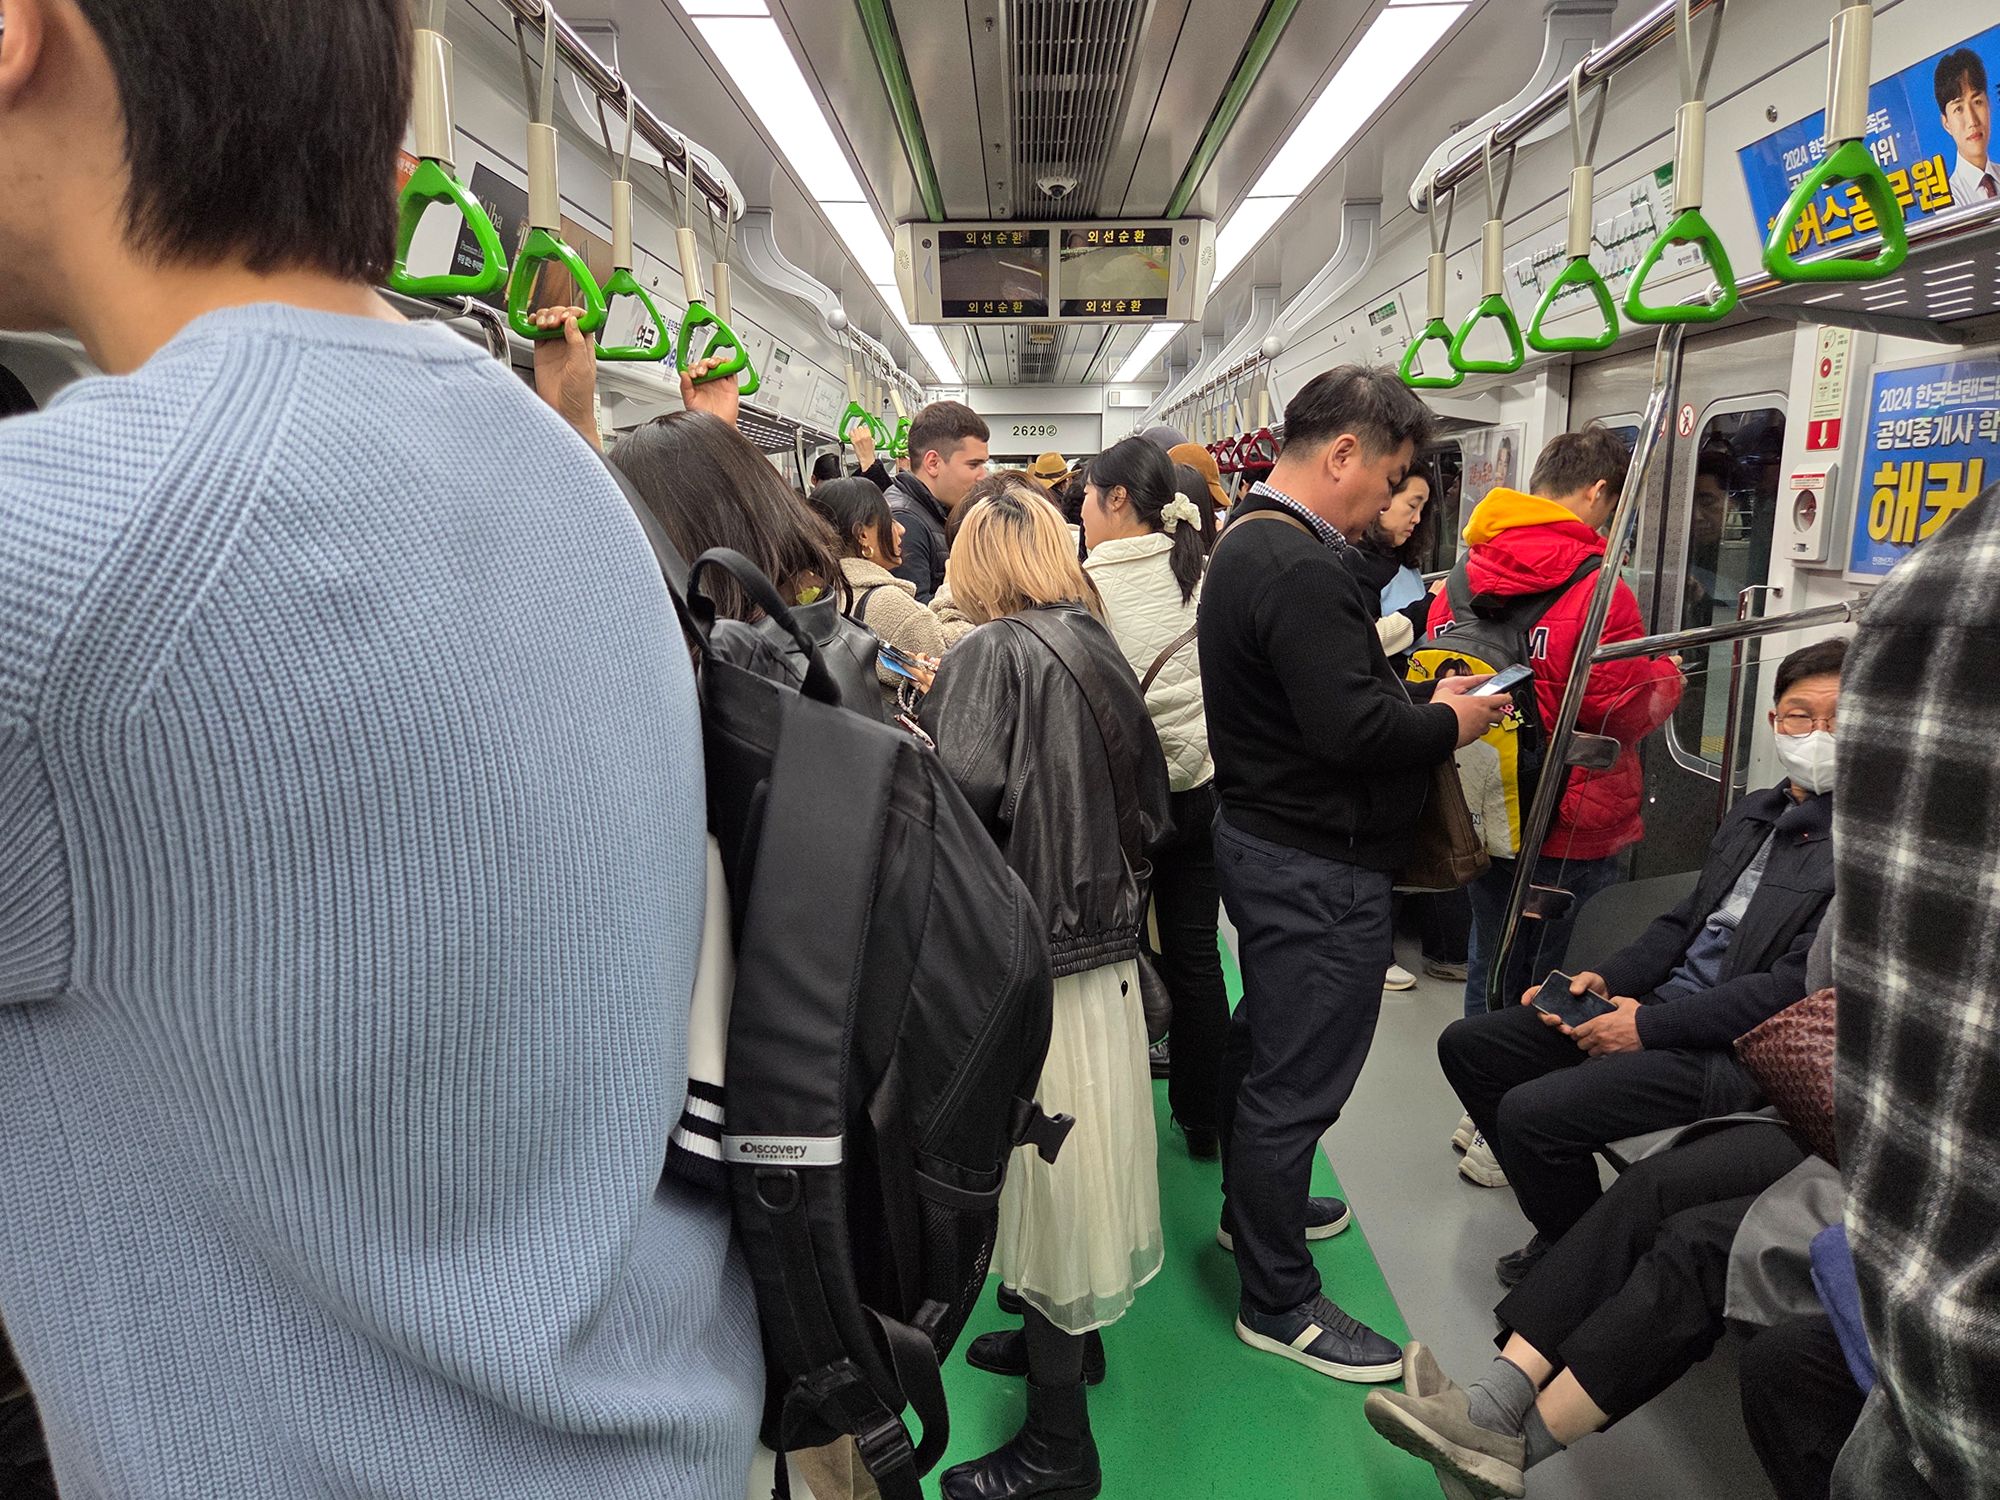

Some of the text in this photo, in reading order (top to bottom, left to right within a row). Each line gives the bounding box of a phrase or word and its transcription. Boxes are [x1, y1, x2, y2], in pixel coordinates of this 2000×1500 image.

[1783, 145, 1808, 171] 2024
[1767, 155, 1953, 254] 커스공무원
[966, 232, 1023, 245] 외선순환
[1088, 230, 1145, 244] 외선순환
[968, 302, 1023, 314] 외선순환
[1086, 300, 1142, 312] 외선순환
[1879, 386, 1912, 413] 2024
[1876, 415, 1974, 450] 공인중개사
[740, 1142, 807, 1158] Discovery
